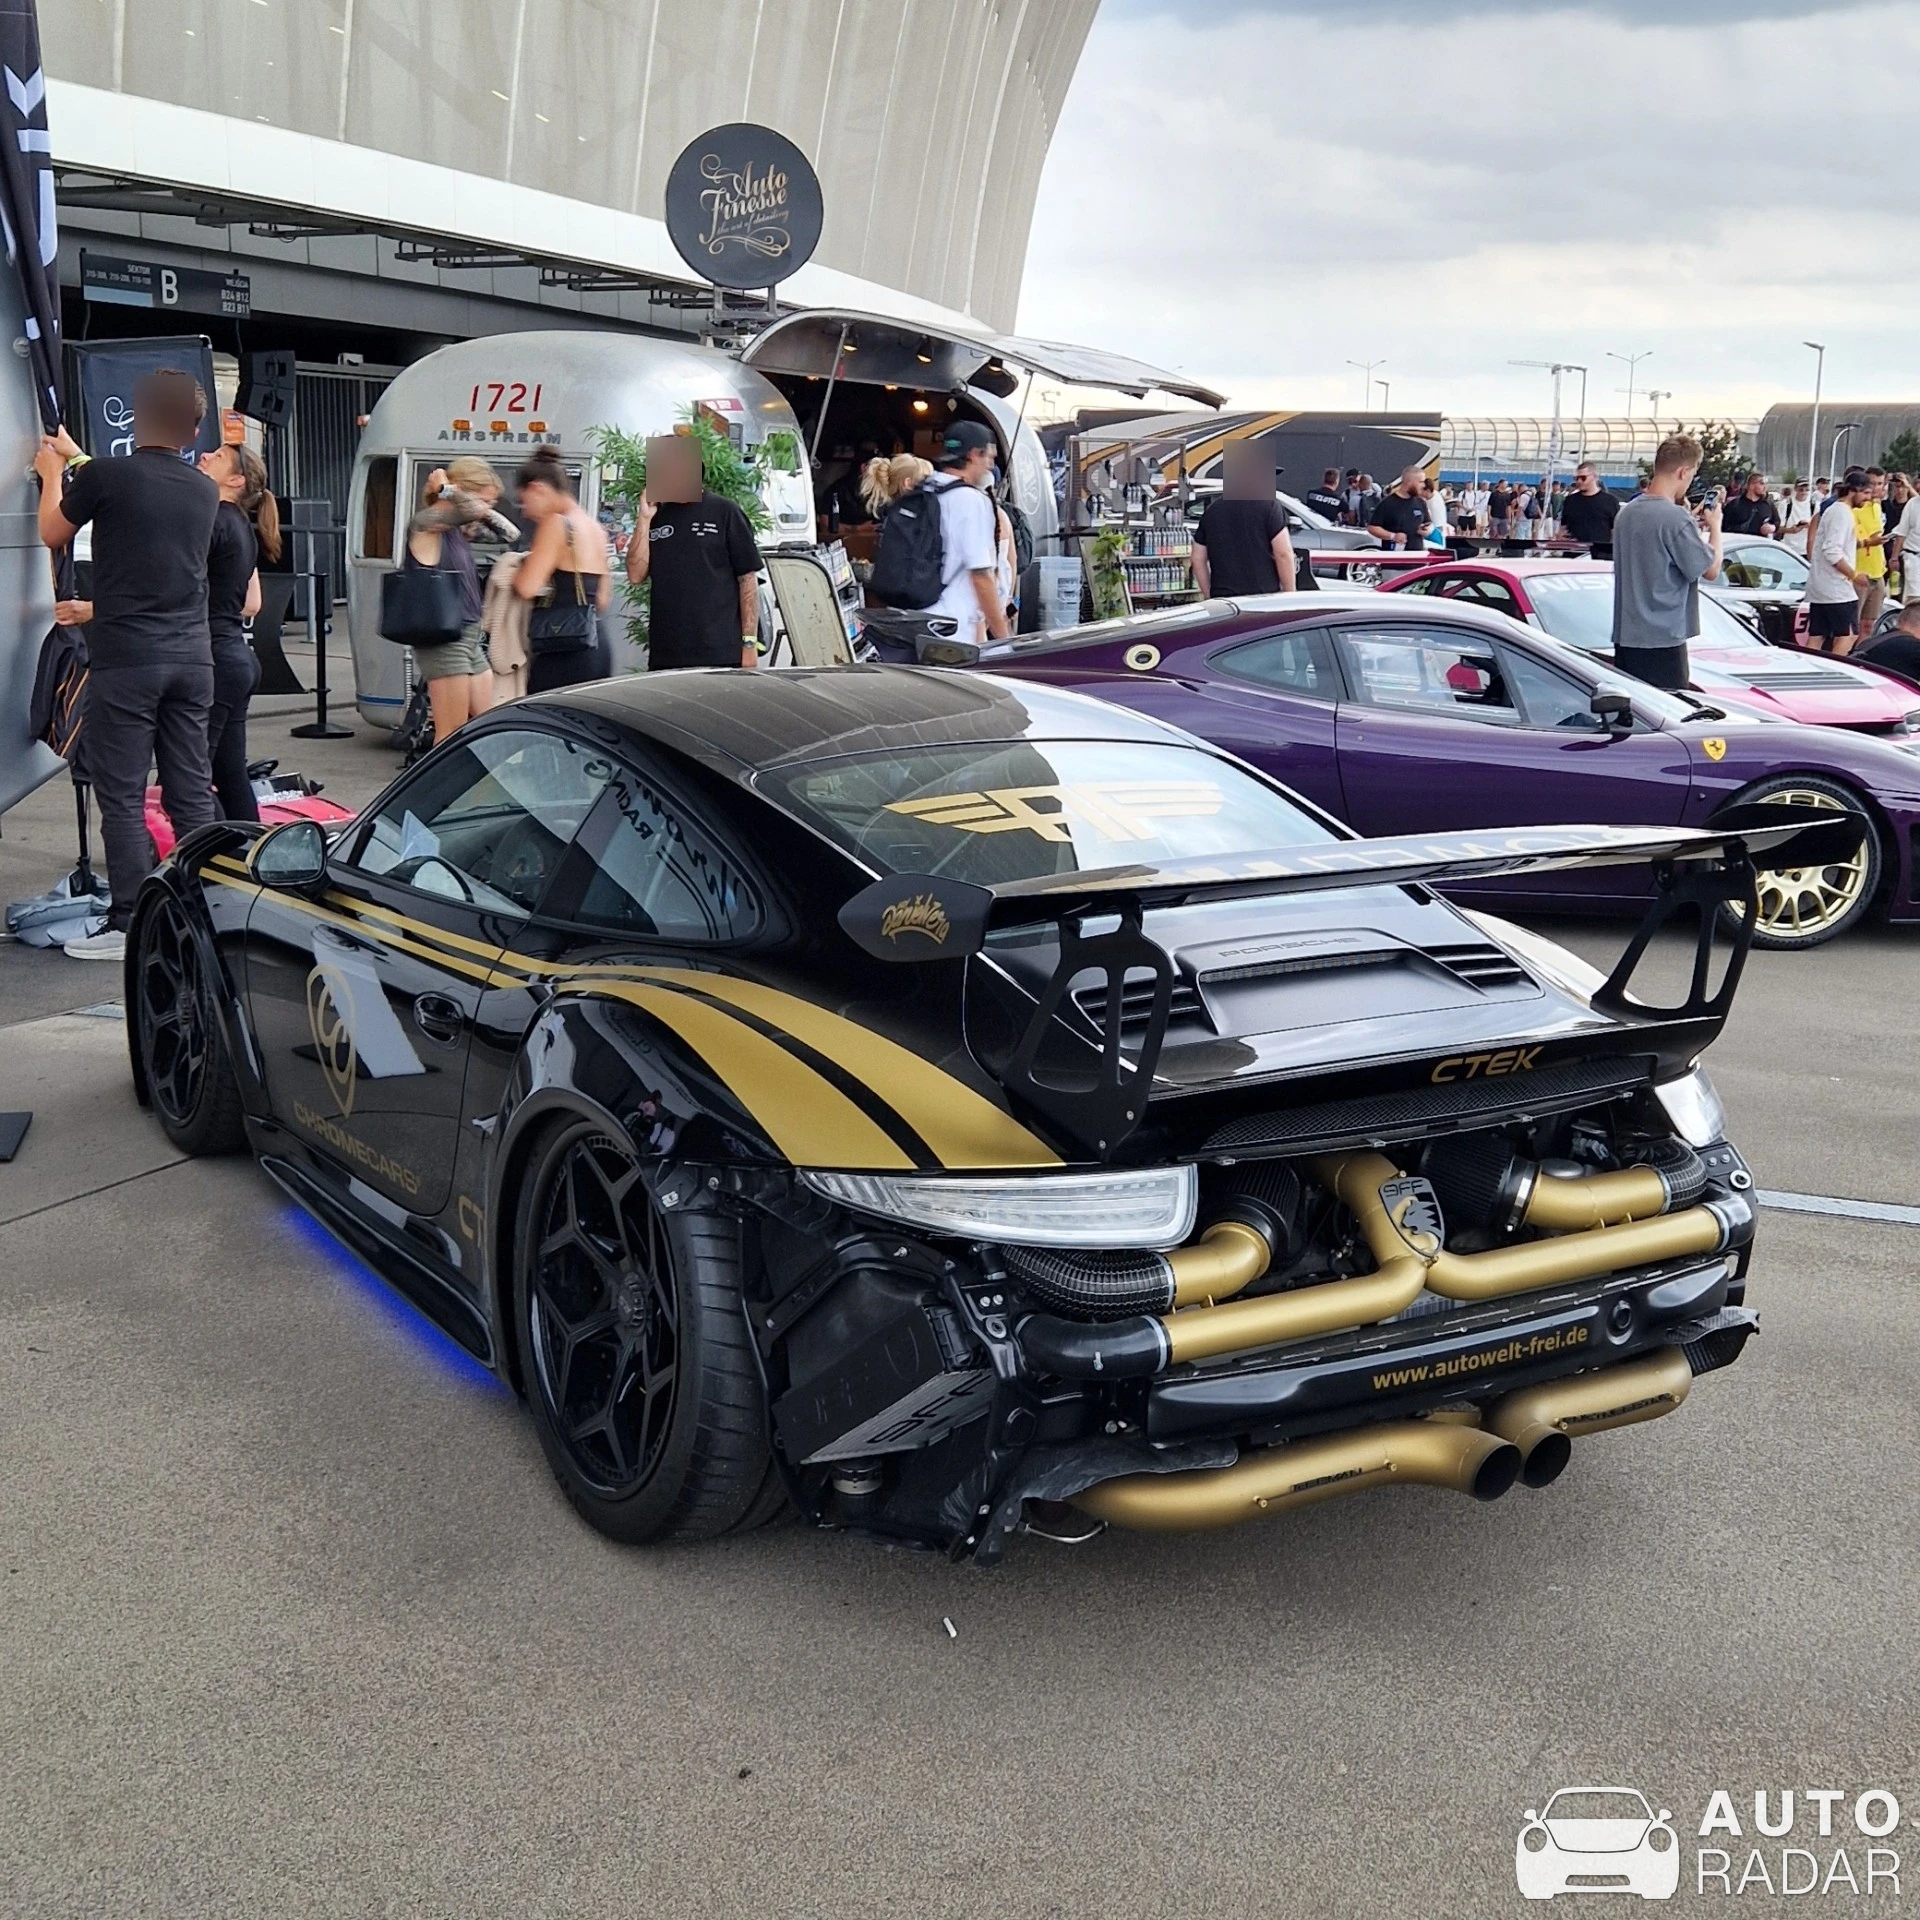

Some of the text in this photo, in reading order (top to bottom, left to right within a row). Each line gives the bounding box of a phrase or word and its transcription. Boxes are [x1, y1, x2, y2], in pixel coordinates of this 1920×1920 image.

[714, 158, 788, 203] Auto
[699, 187, 787, 245] Finesse
[160, 269, 178, 305] B
[221, 289, 249, 303] B24 B12
[222, 301, 249, 315] B23 B11
[470, 383, 542, 412] 1721
[438, 430, 562, 445] AIRSTREAM
[1218, 937, 1361, 957] PORSCHE
[1431, 1046, 1544, 1083] CTEK
[294, 1100, 419, 1195] CHROMECARS
[1372, 1325, 1588, 1390] www.autowelt-frei.de
